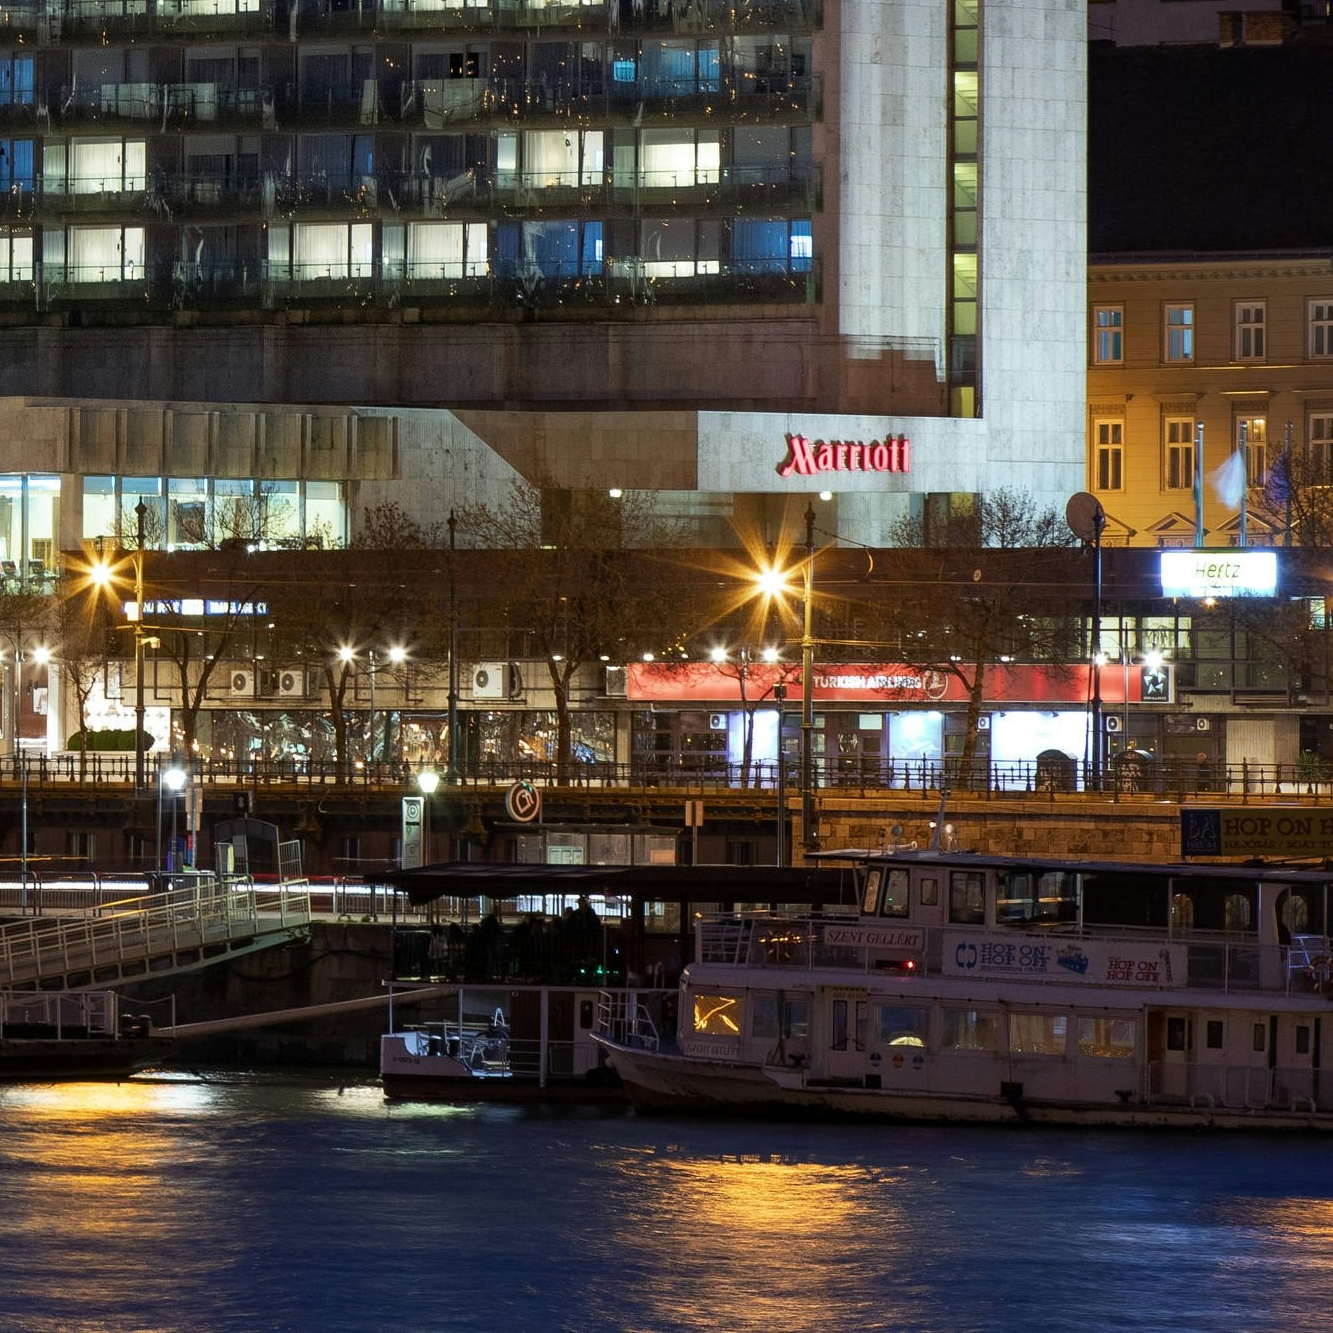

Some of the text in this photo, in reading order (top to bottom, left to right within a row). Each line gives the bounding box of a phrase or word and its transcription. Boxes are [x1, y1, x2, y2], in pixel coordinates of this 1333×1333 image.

[779, 433, 913, 477] Marriott
[1195, 561, 1241, 578] Hertz
[813, 675, 866, 688] TURKISH
[1223, 817, 1271, 836] HOP
[1277, 818, 1314, 836] ON
[1285, 840, 1317, 849] BOAT
[827, 930, 864, 945] SZENT
[981, 943, 1047, 956] HOP ON
[981, 954, 1050, 967] HOP OFF
[1108, 960, 1159, 972] HOP ON
[1107, 970, 1133, 981] HOP
